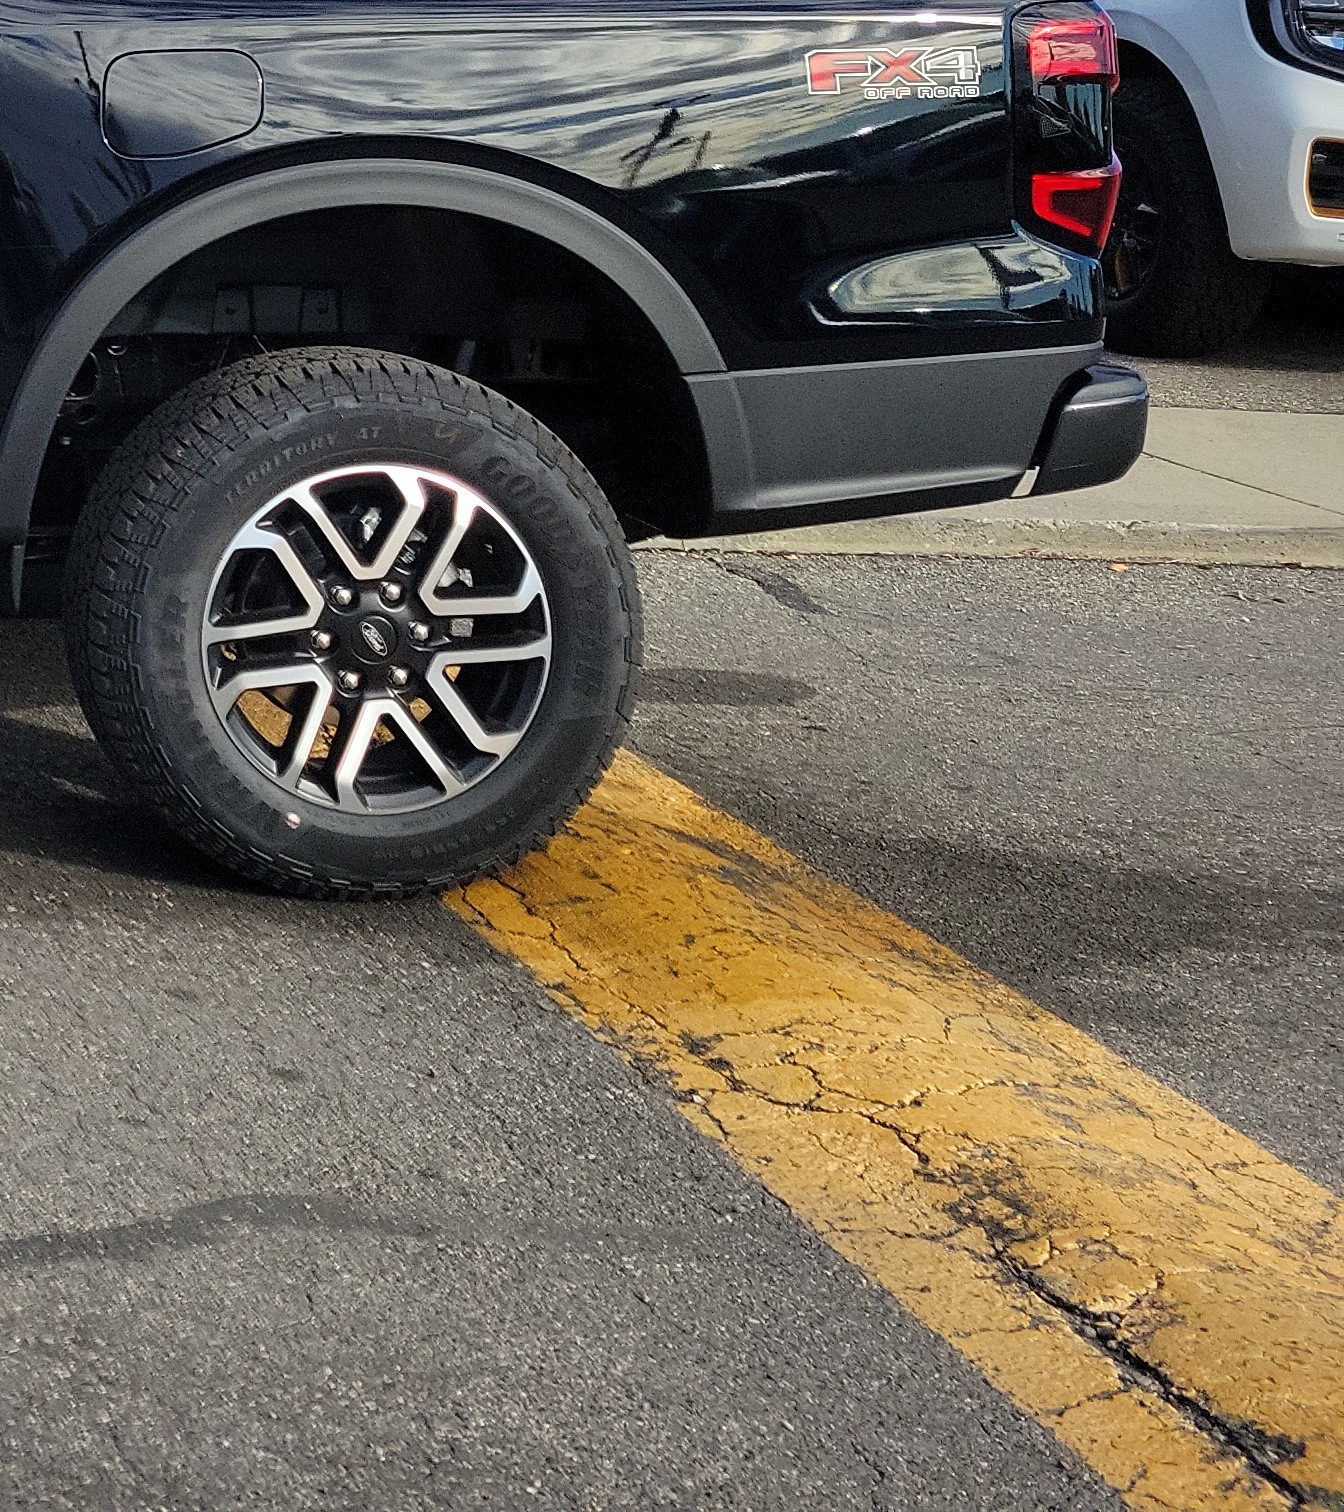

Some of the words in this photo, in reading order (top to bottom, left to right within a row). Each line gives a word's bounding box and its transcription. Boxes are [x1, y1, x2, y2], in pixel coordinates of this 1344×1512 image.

[805, 46, 981, 94] FX4
[864, 87, 911, 99] OFF
[917, 86, 980, 98] ROAD
